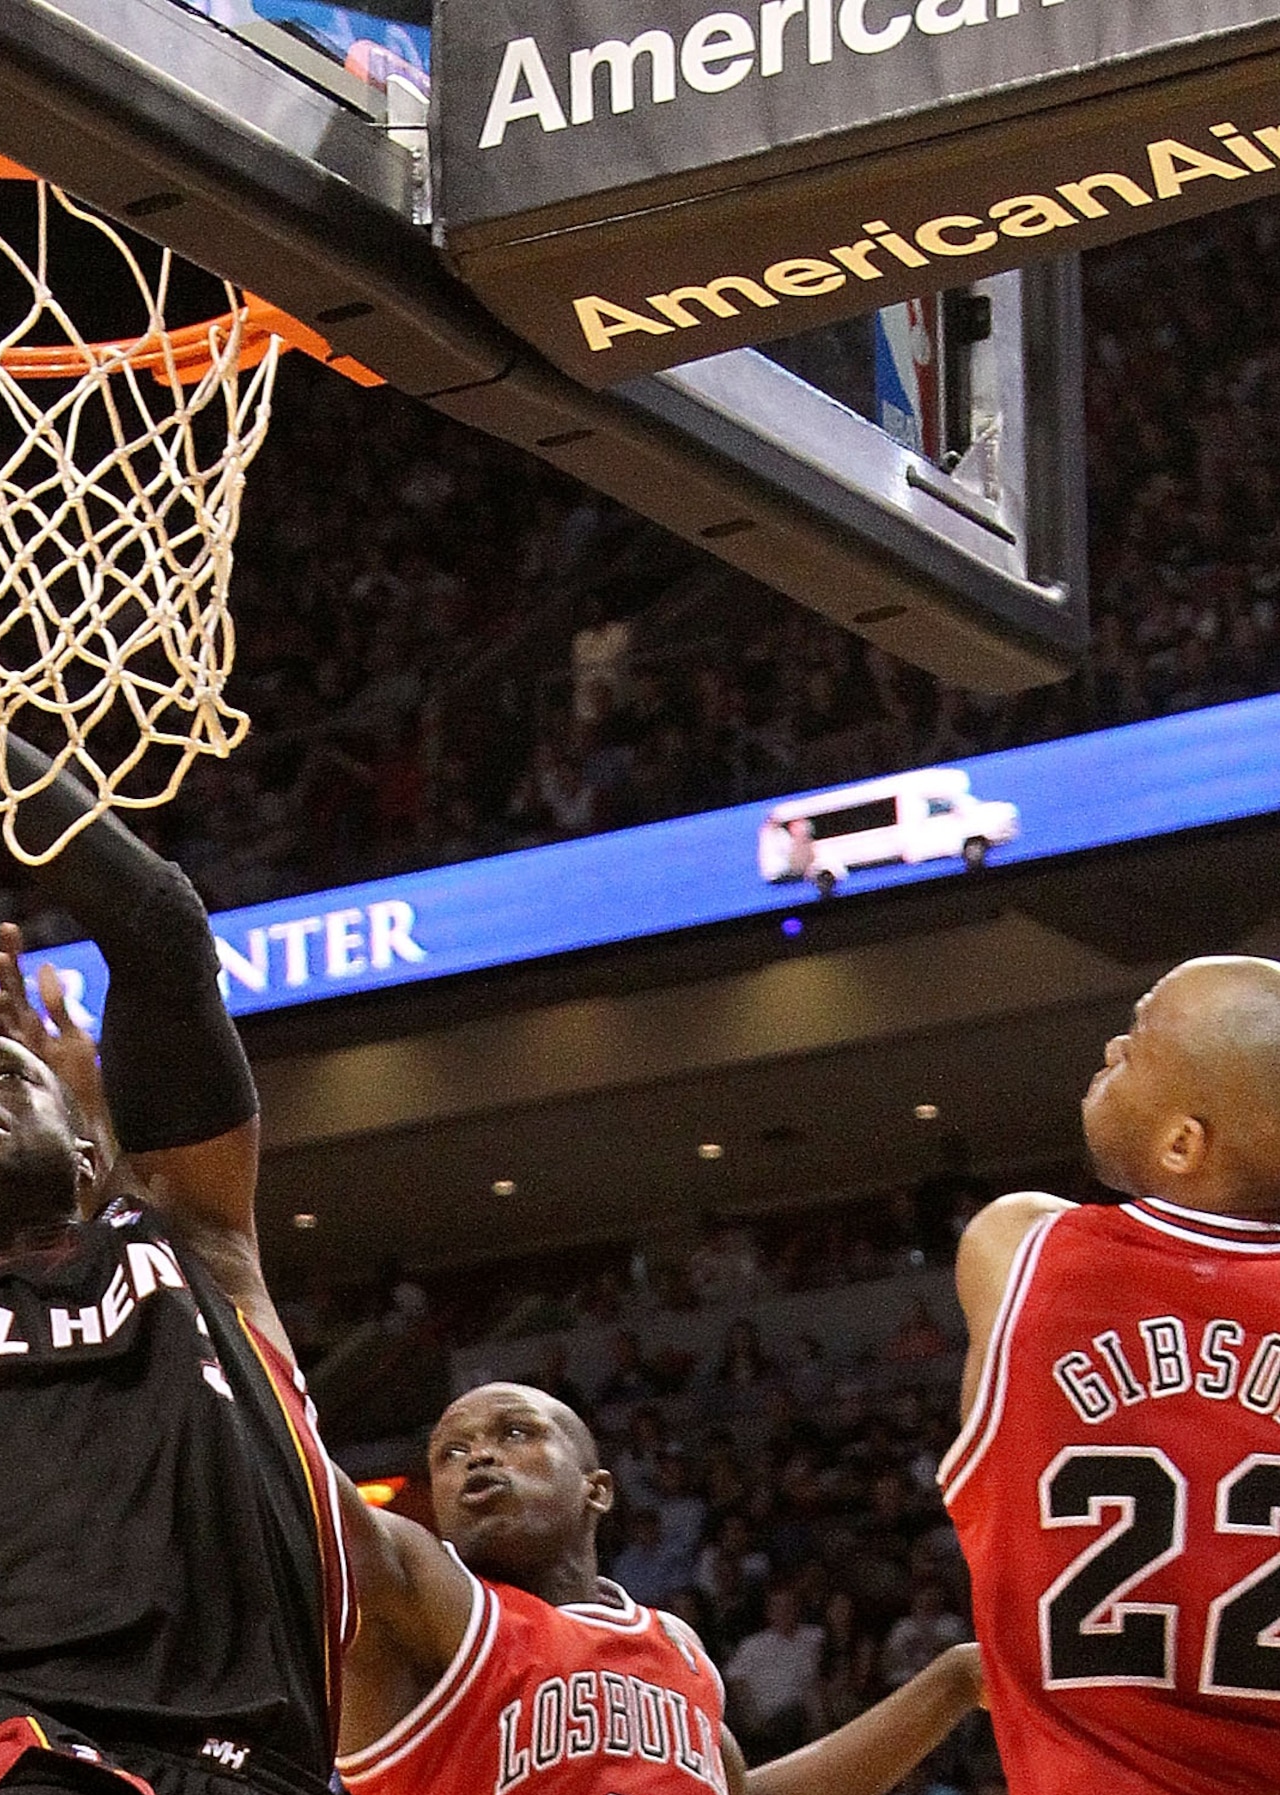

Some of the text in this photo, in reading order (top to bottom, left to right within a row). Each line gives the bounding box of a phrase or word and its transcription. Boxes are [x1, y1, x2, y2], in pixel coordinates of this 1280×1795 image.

[478, 0, 1066, 150] Americ
[214, 900, 429, 999] NTER
[50, 1240, 188, 1348] HEA
[1052, 1315, 1280, 1424] GIBSO
